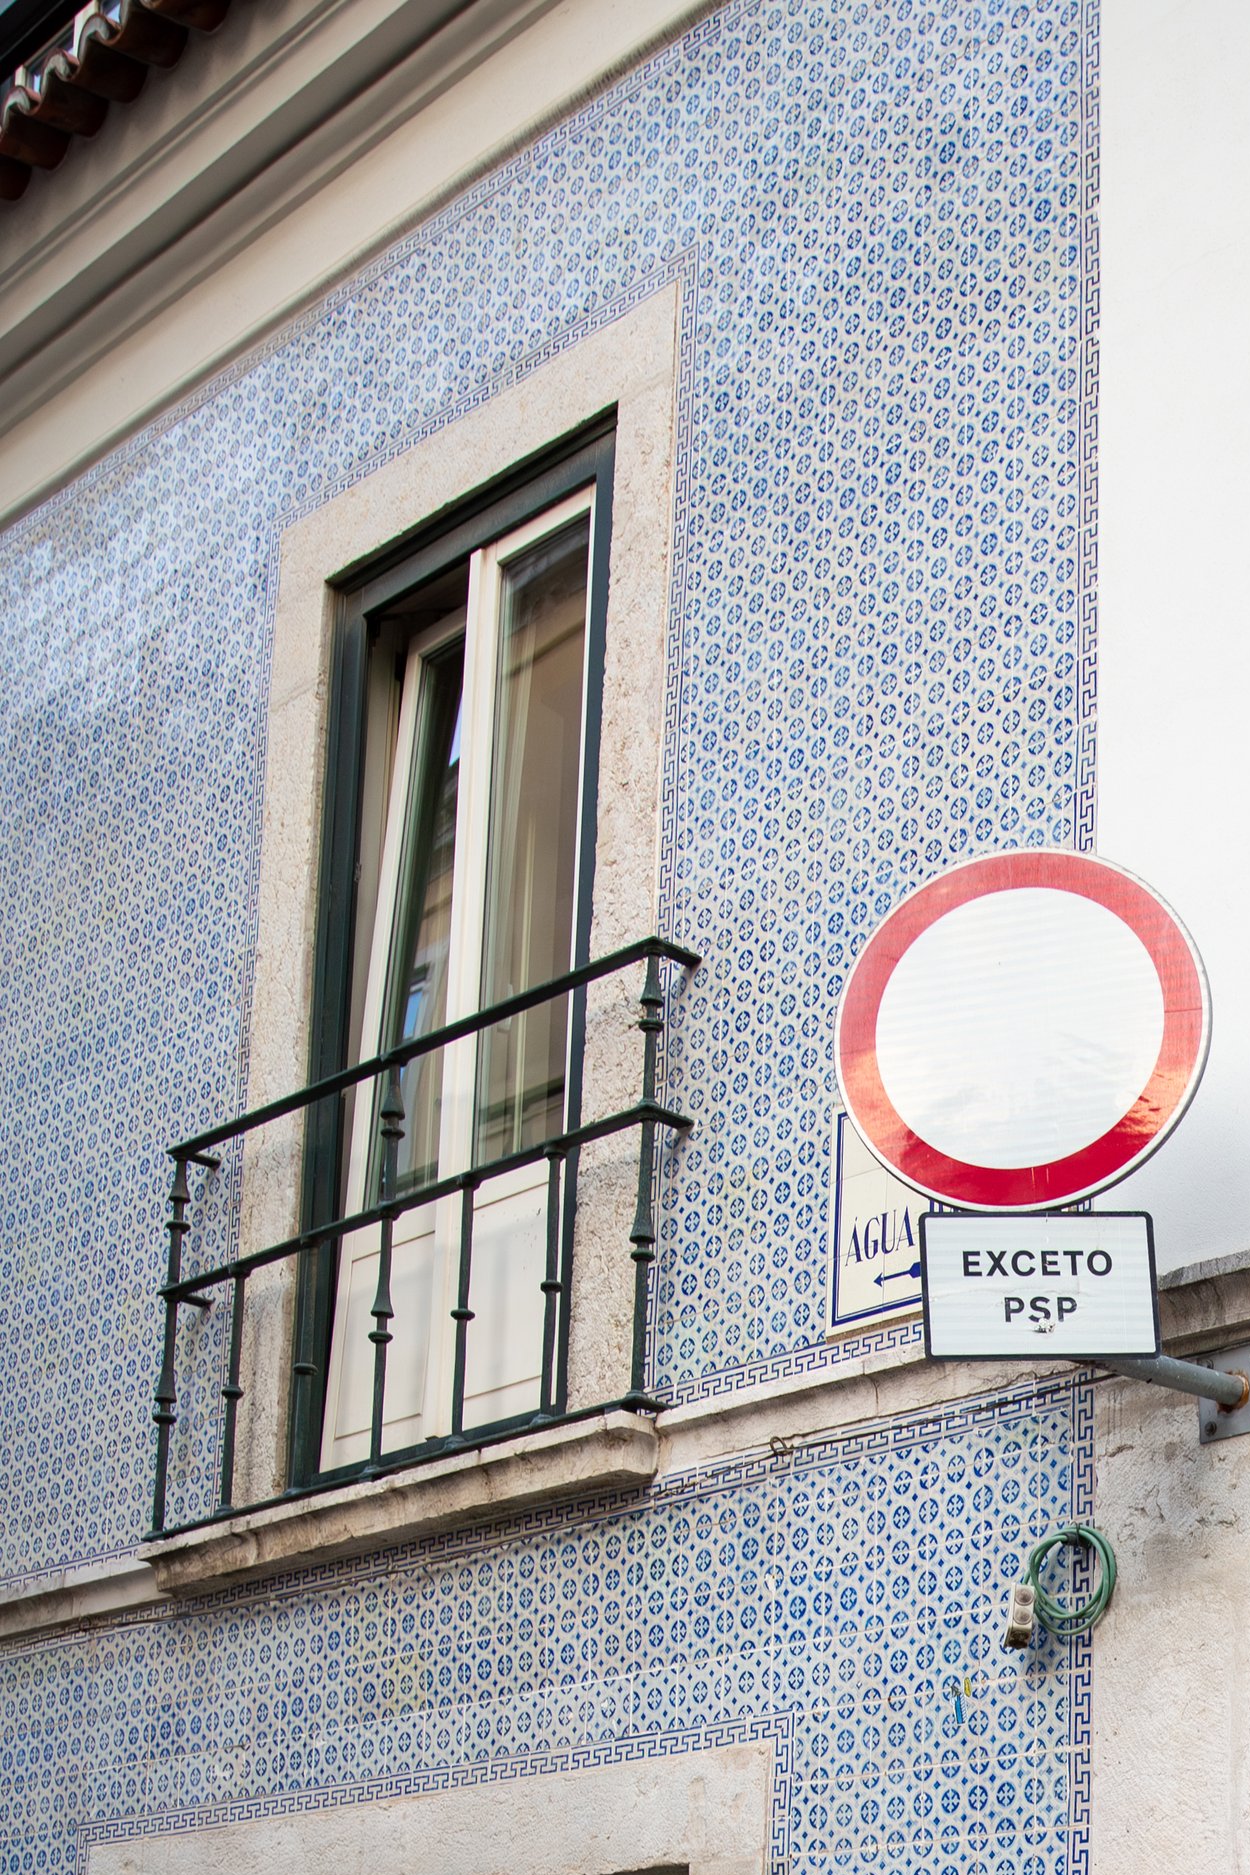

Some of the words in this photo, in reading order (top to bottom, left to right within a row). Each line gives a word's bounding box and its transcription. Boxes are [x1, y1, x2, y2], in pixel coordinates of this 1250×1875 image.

[844, 1205, 916, 1268] ÁGUA
[961, 1249, 1114, 1278] EXCETO
[1003, 1295, 1079, 1323] PSP
